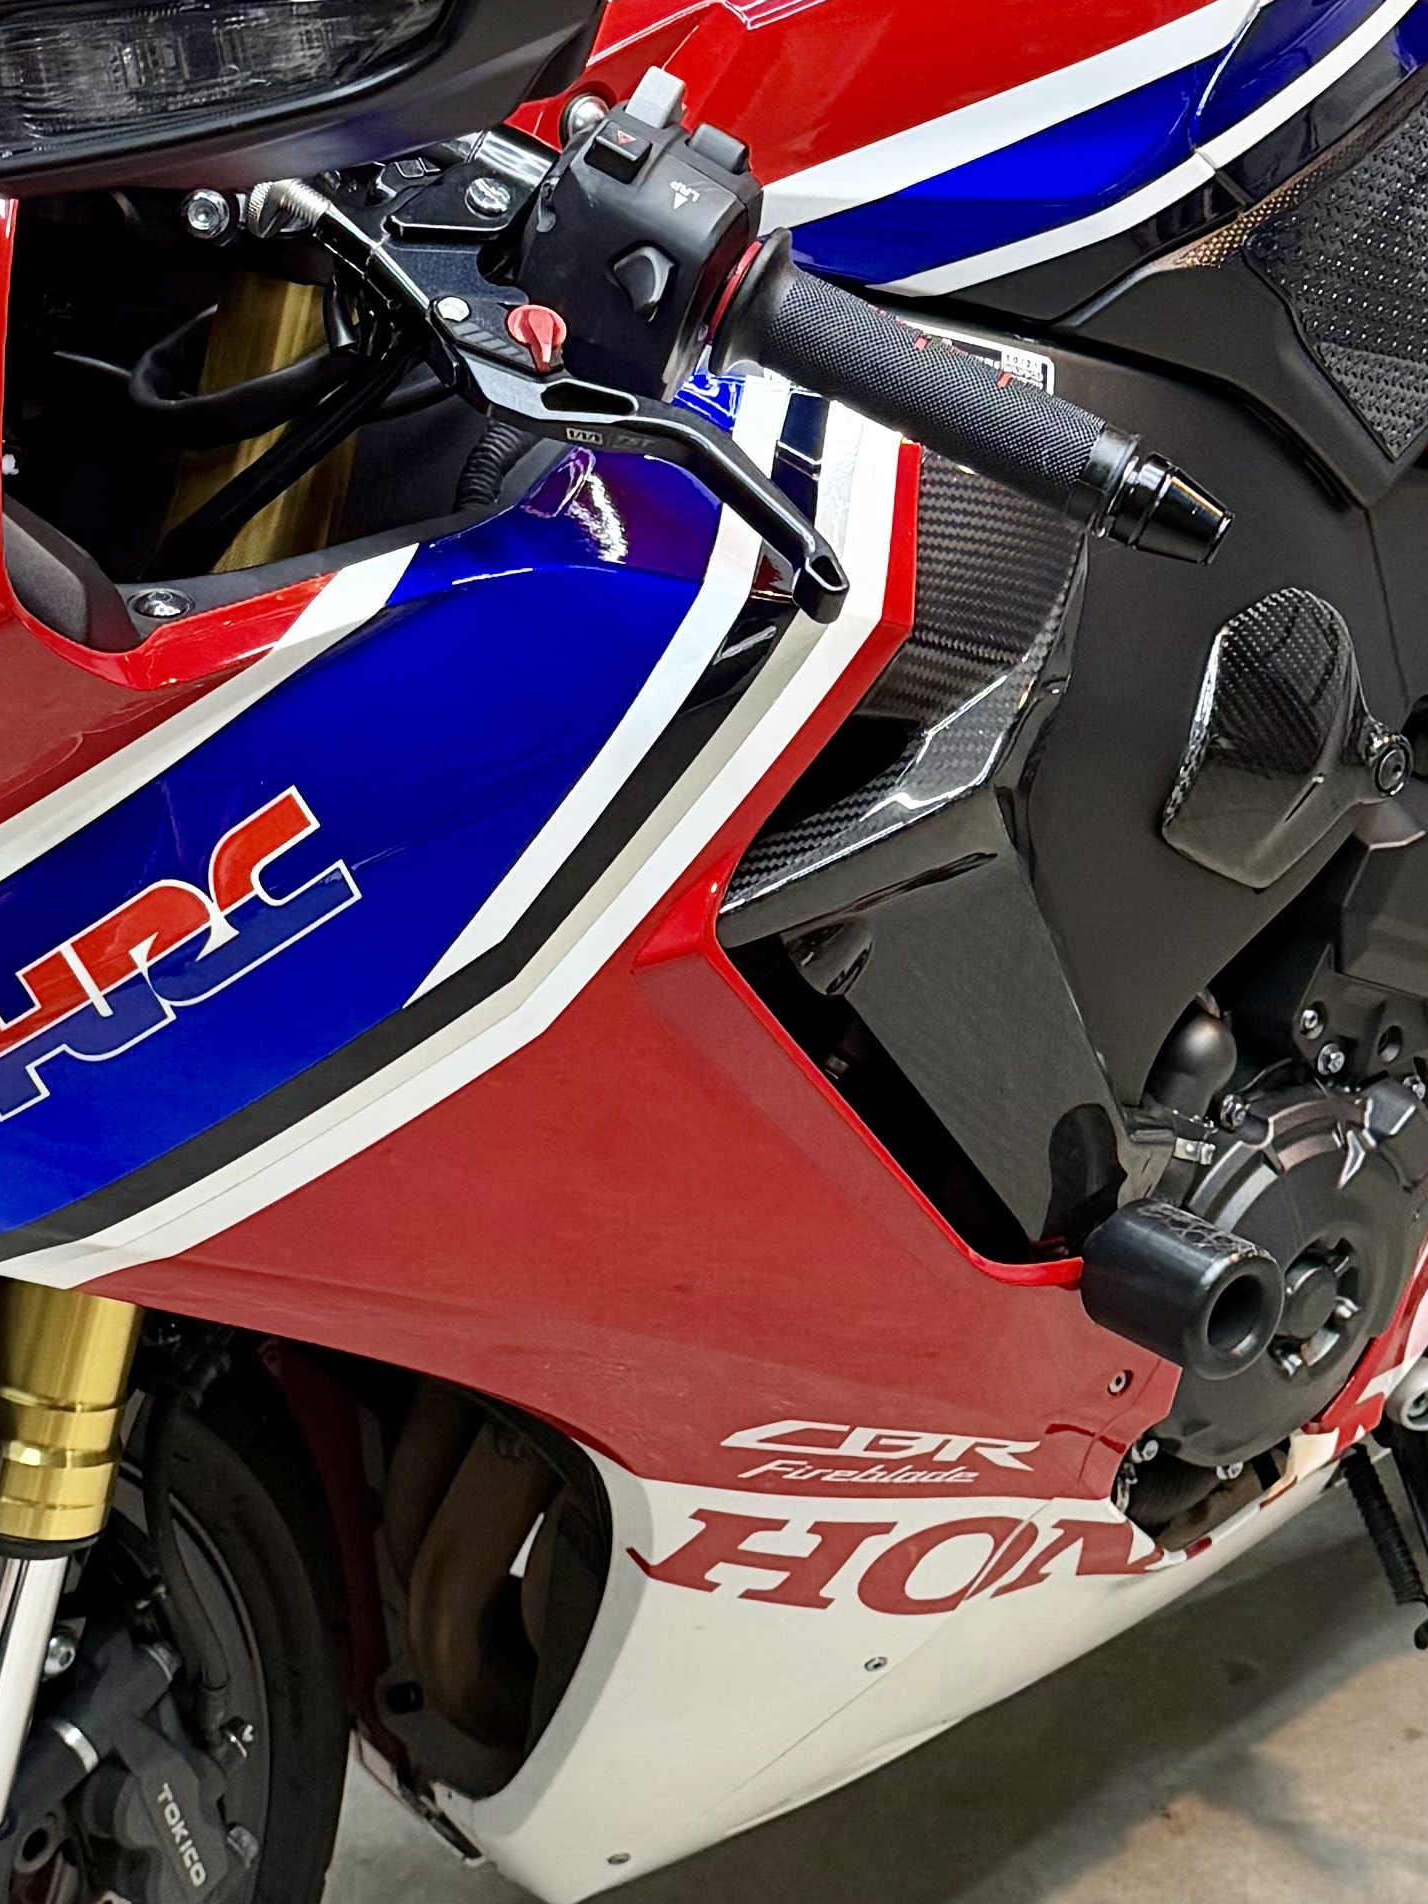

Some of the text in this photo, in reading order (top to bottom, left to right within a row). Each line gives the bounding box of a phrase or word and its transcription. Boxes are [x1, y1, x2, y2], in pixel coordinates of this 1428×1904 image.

[720, 1419, 1041, 1471] CBR
[738, 1459, 977, 1484] Fireblade
[156, 1782, 207, 1889] TOKICO
